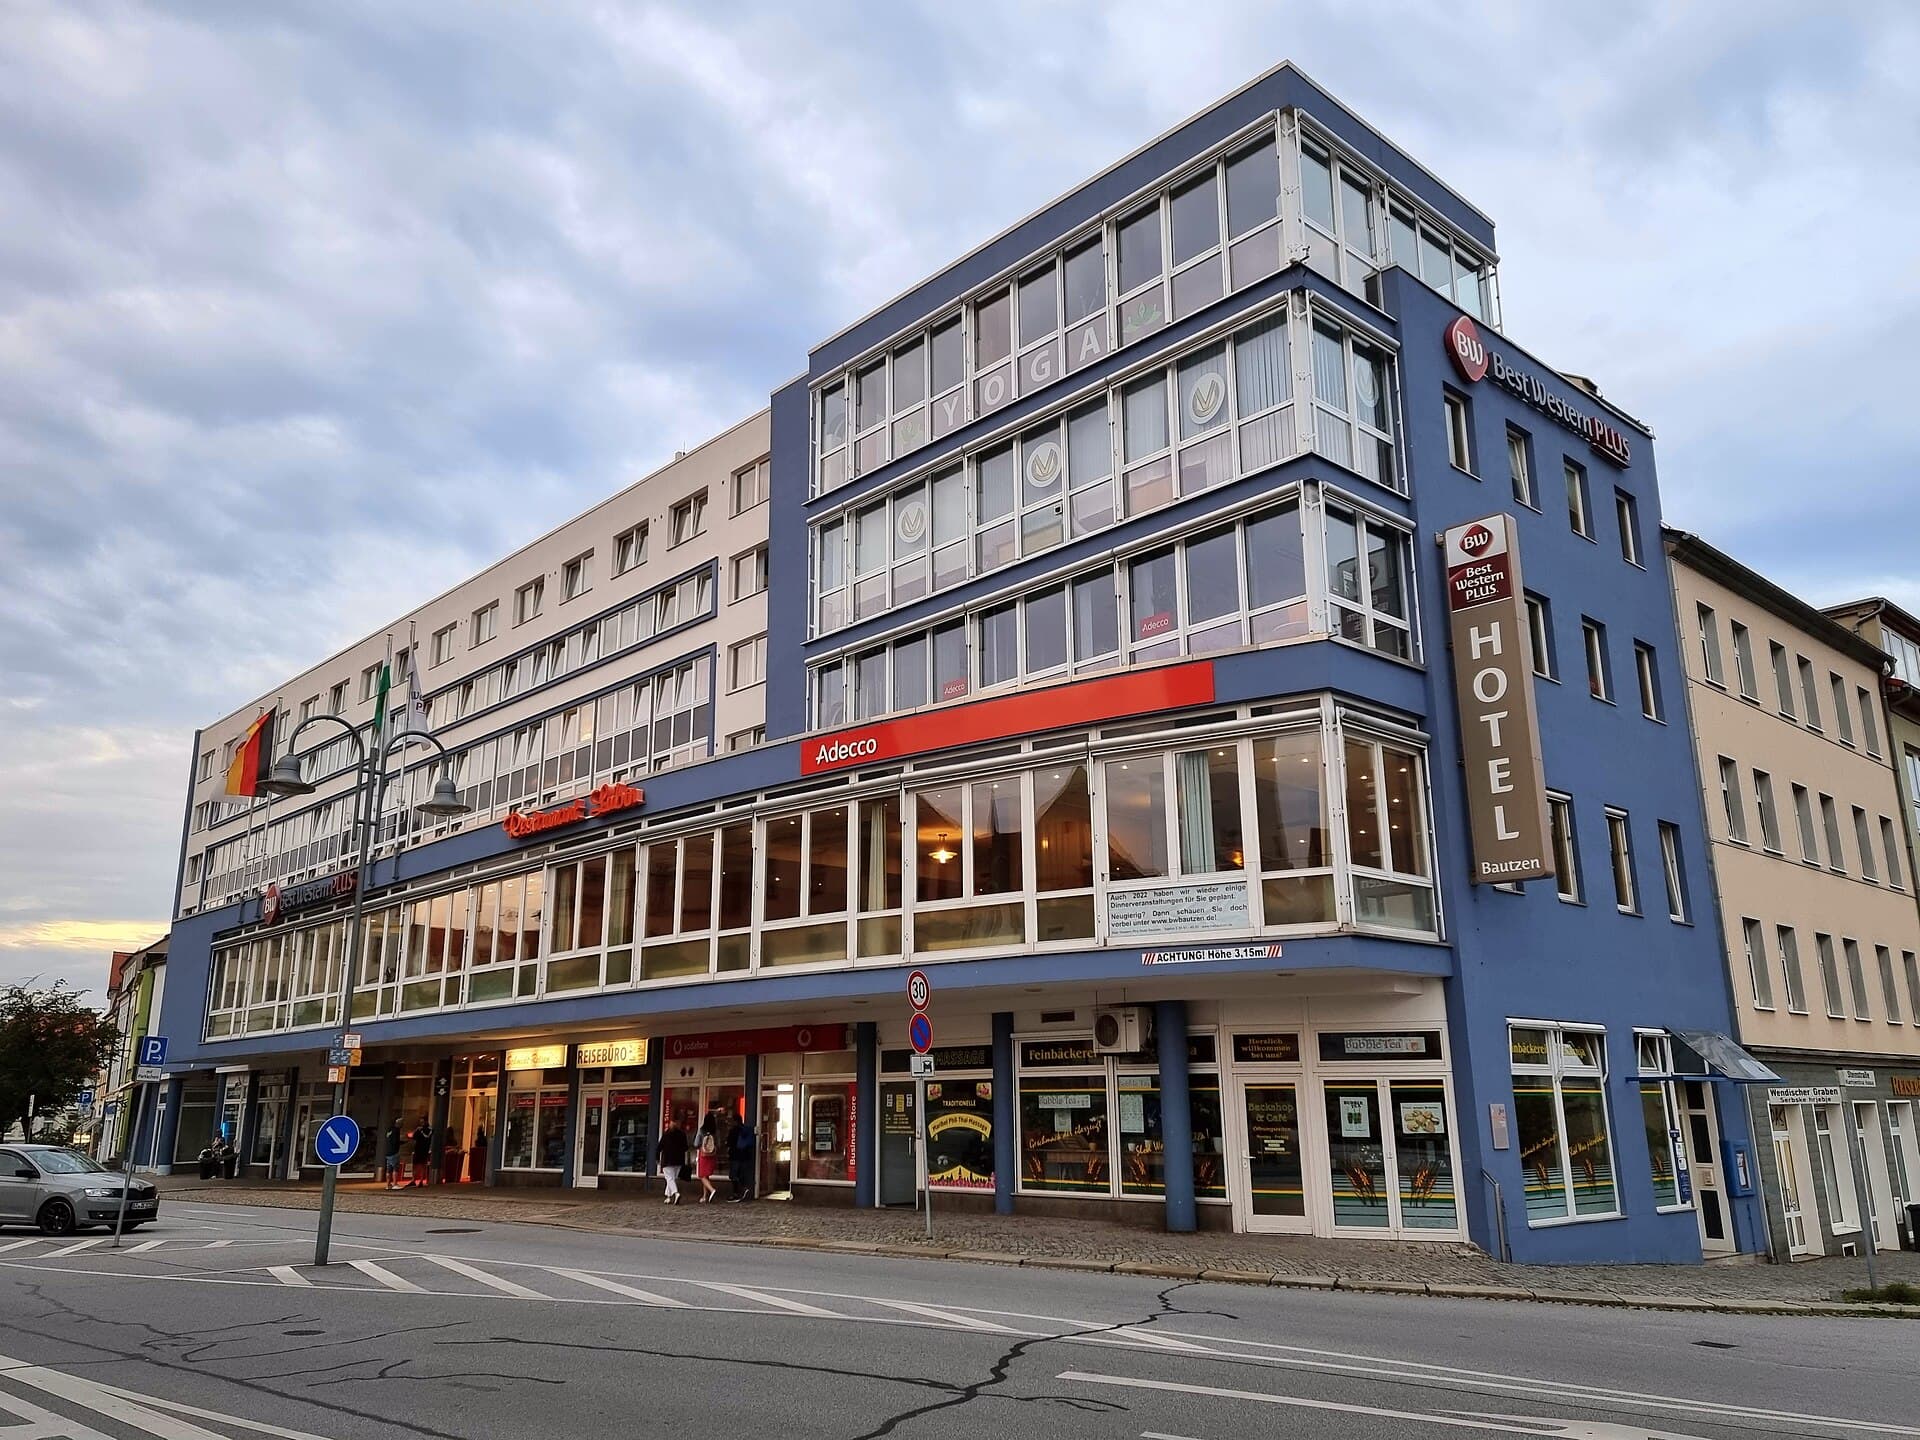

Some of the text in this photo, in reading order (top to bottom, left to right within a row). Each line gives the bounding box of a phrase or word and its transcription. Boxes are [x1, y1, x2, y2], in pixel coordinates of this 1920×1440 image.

[1457, 331, 1483, 366] BW
[942, 326, 1101, 427] YOGA
[1491, 352, 1631, 461] Best Western PLUS
[1464, 532, 1489, 550] BW
[1466, 563, 1493, 578] Best
[1456, 571, 1505, 591] Western
[1142, 616, 1169, 633] Adecco
[944, 682, 965, 696] Adecco
[1470, 621, 1521, 841] HOTEL
[815, 736, 878, 766] Adecco
[1482, 856, 1541, 876] Bautzen
[264, 895, 277, 914] BW
[330, 869, 356, 898] PLUS
[1110, 893, 1127, 901] Auch
[1132, 891, 1148, 899] 2022
[1197, 886, 1219, 894] wieder
[1225, 884, 1246, 893] einige
[1110, 898, 1183, 909] Dinnerveranstaltungen
[1208, 893, 1236, 902] geplant.
[1111, 911, 1146, 921] Neugierig?
[1176, 907, 1205, 915] schauen
[1230, 904, 1247, 912] doch
[1111, 920, 1131, 928] vorbei
[1133, 919, 1150, 927] unter
[1156, 951, 1205, 962] ACHTUNG!
[1208, 949, 1232, 959] Höhe
[912, 981, 925, 999] 30
[146, 1040, 162, 1061] P
[577, 1044, 627, 1065] REISEBÜRO
[935, 1050, 985, 1066] MASSAGE
[1770, 1087, 1839, 1097] Wendischer Graben
